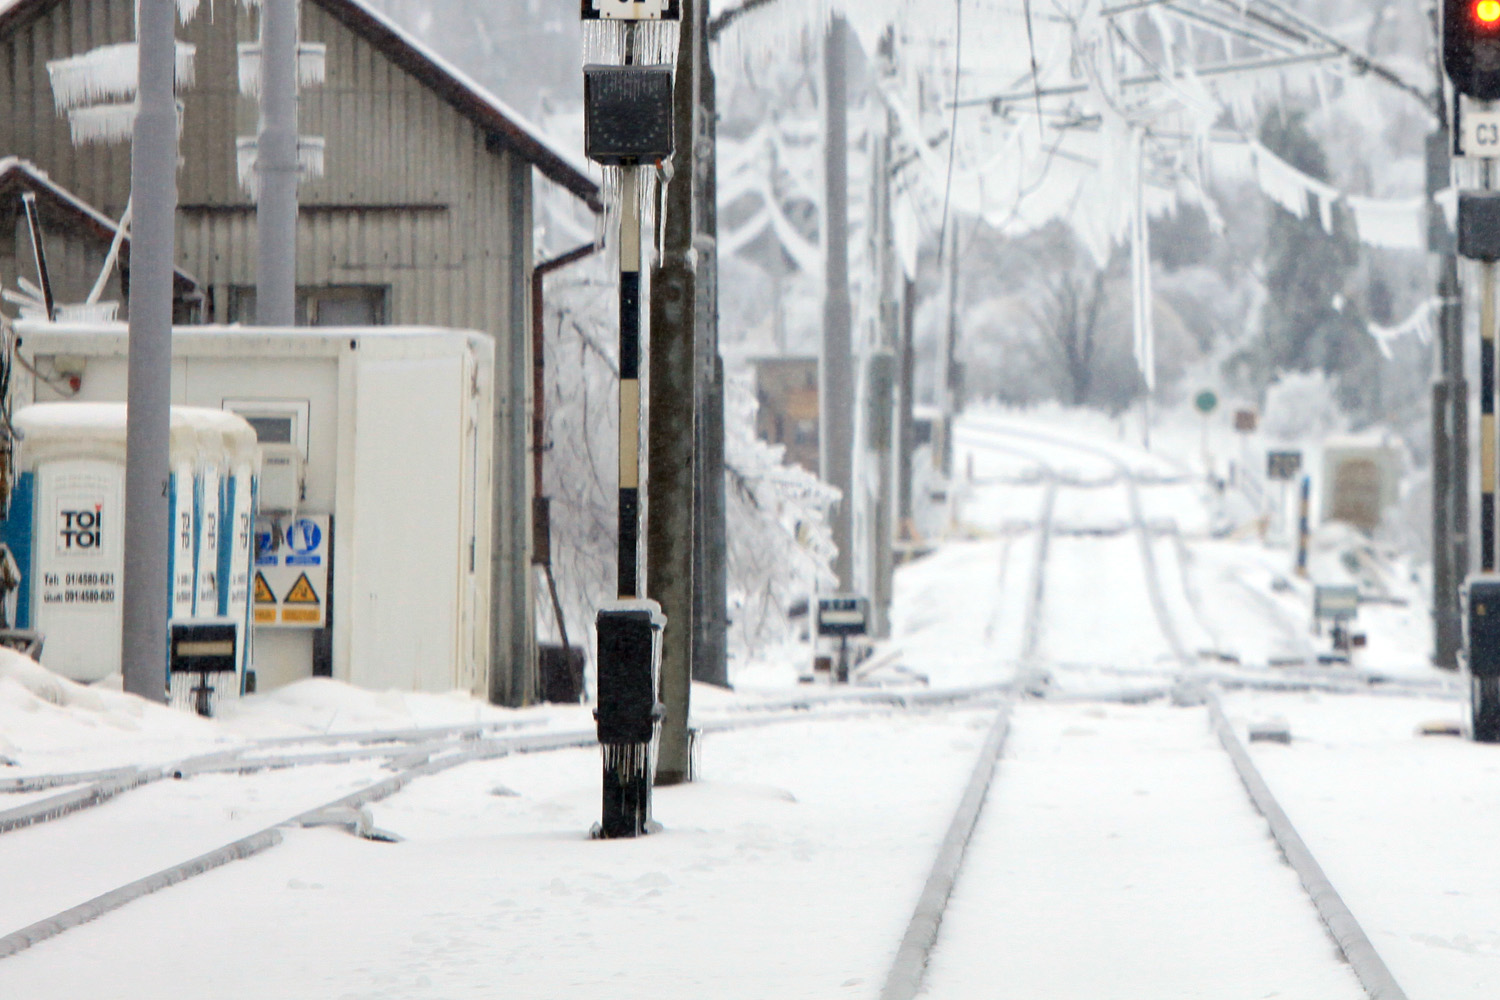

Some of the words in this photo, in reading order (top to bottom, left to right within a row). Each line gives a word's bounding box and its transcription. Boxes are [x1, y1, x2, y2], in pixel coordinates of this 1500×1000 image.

[1476, 122, 1498, 146] C3
[60, 506, 102, 529] TOI
[60, 530, 101, 549] TOI
